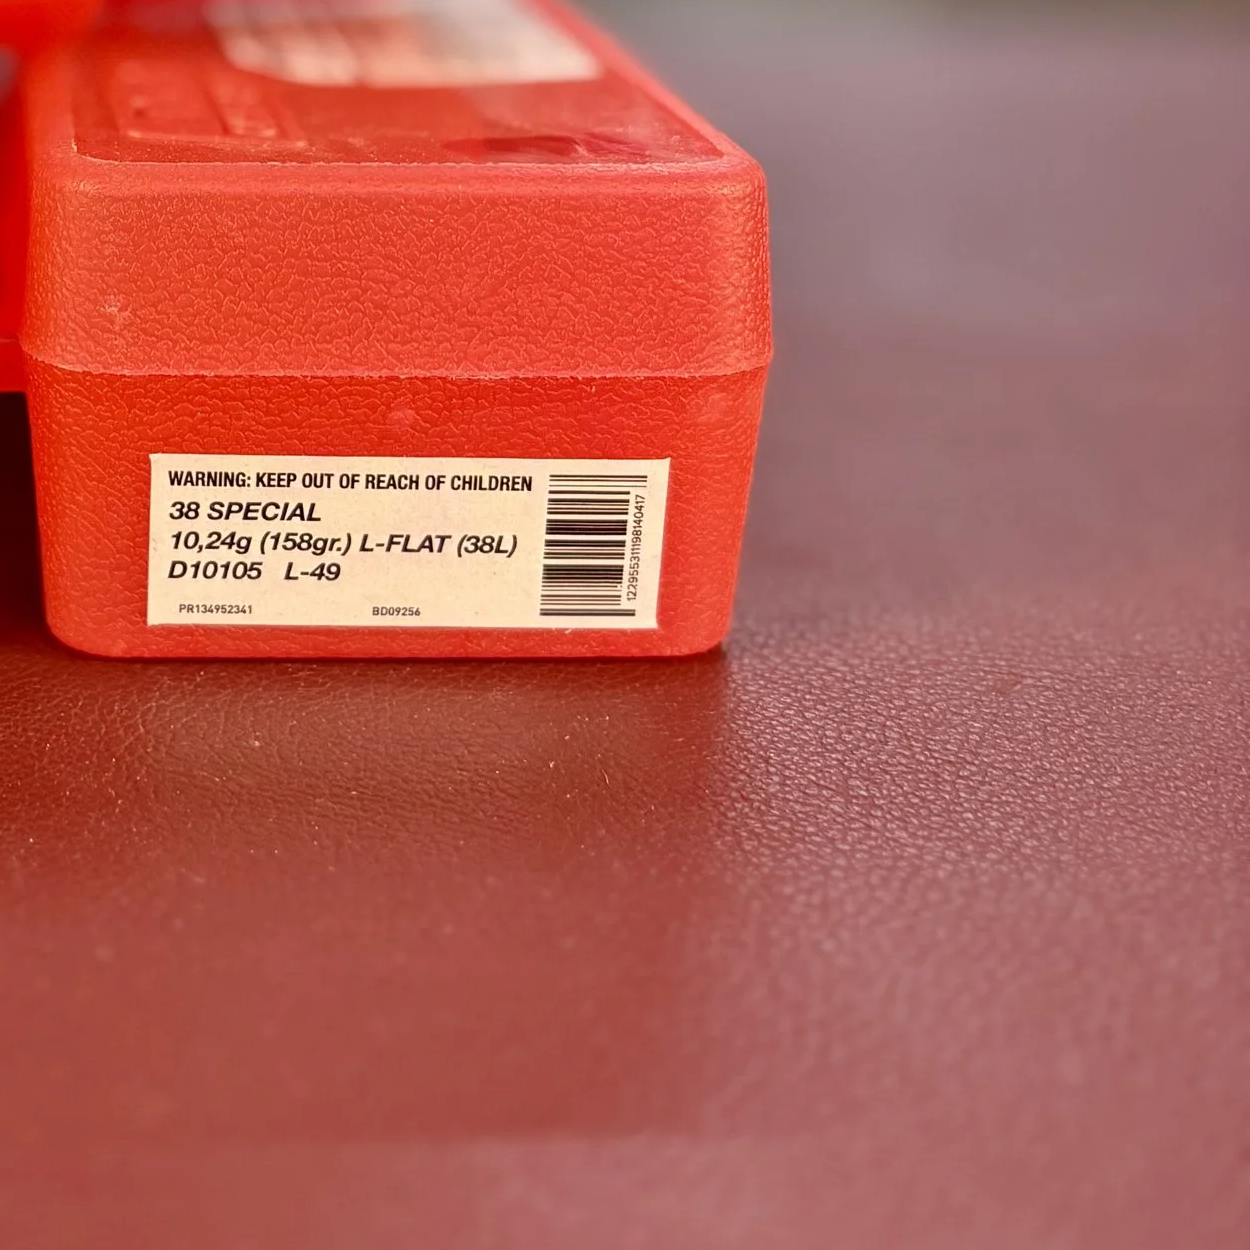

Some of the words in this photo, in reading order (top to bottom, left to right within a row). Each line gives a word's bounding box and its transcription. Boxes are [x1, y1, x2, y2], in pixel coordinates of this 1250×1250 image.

[169, 471, 250, 487] WARNING:
[256, 472, 297, 487] KEEP
[302, 473, 334, 488] OUT
[339, 474, 360, 489] OF
[365, 474, 419, 490] REACH
[425, 475, 446, 490] OF
[451, 475, 532, 491] CHILDREN
[170, 501, 200, 520] 38
[207, 502, 321, 521] SPECIAL
[172, 531, 252, 554] 10,24g
[260, 531, 351, 556] (158gr.)
[359, 534, 452, 553] L-FLAT
[457, 535, 517, 558] (38L)
[627, 494, 646, 601] 122955311198140417
[168, 561, 263, 580] D10105
[284, 562, 341, 581] L-49
[178, 603, 252, 615] PR134952341
[372, 606, 421, 617] BD09256
